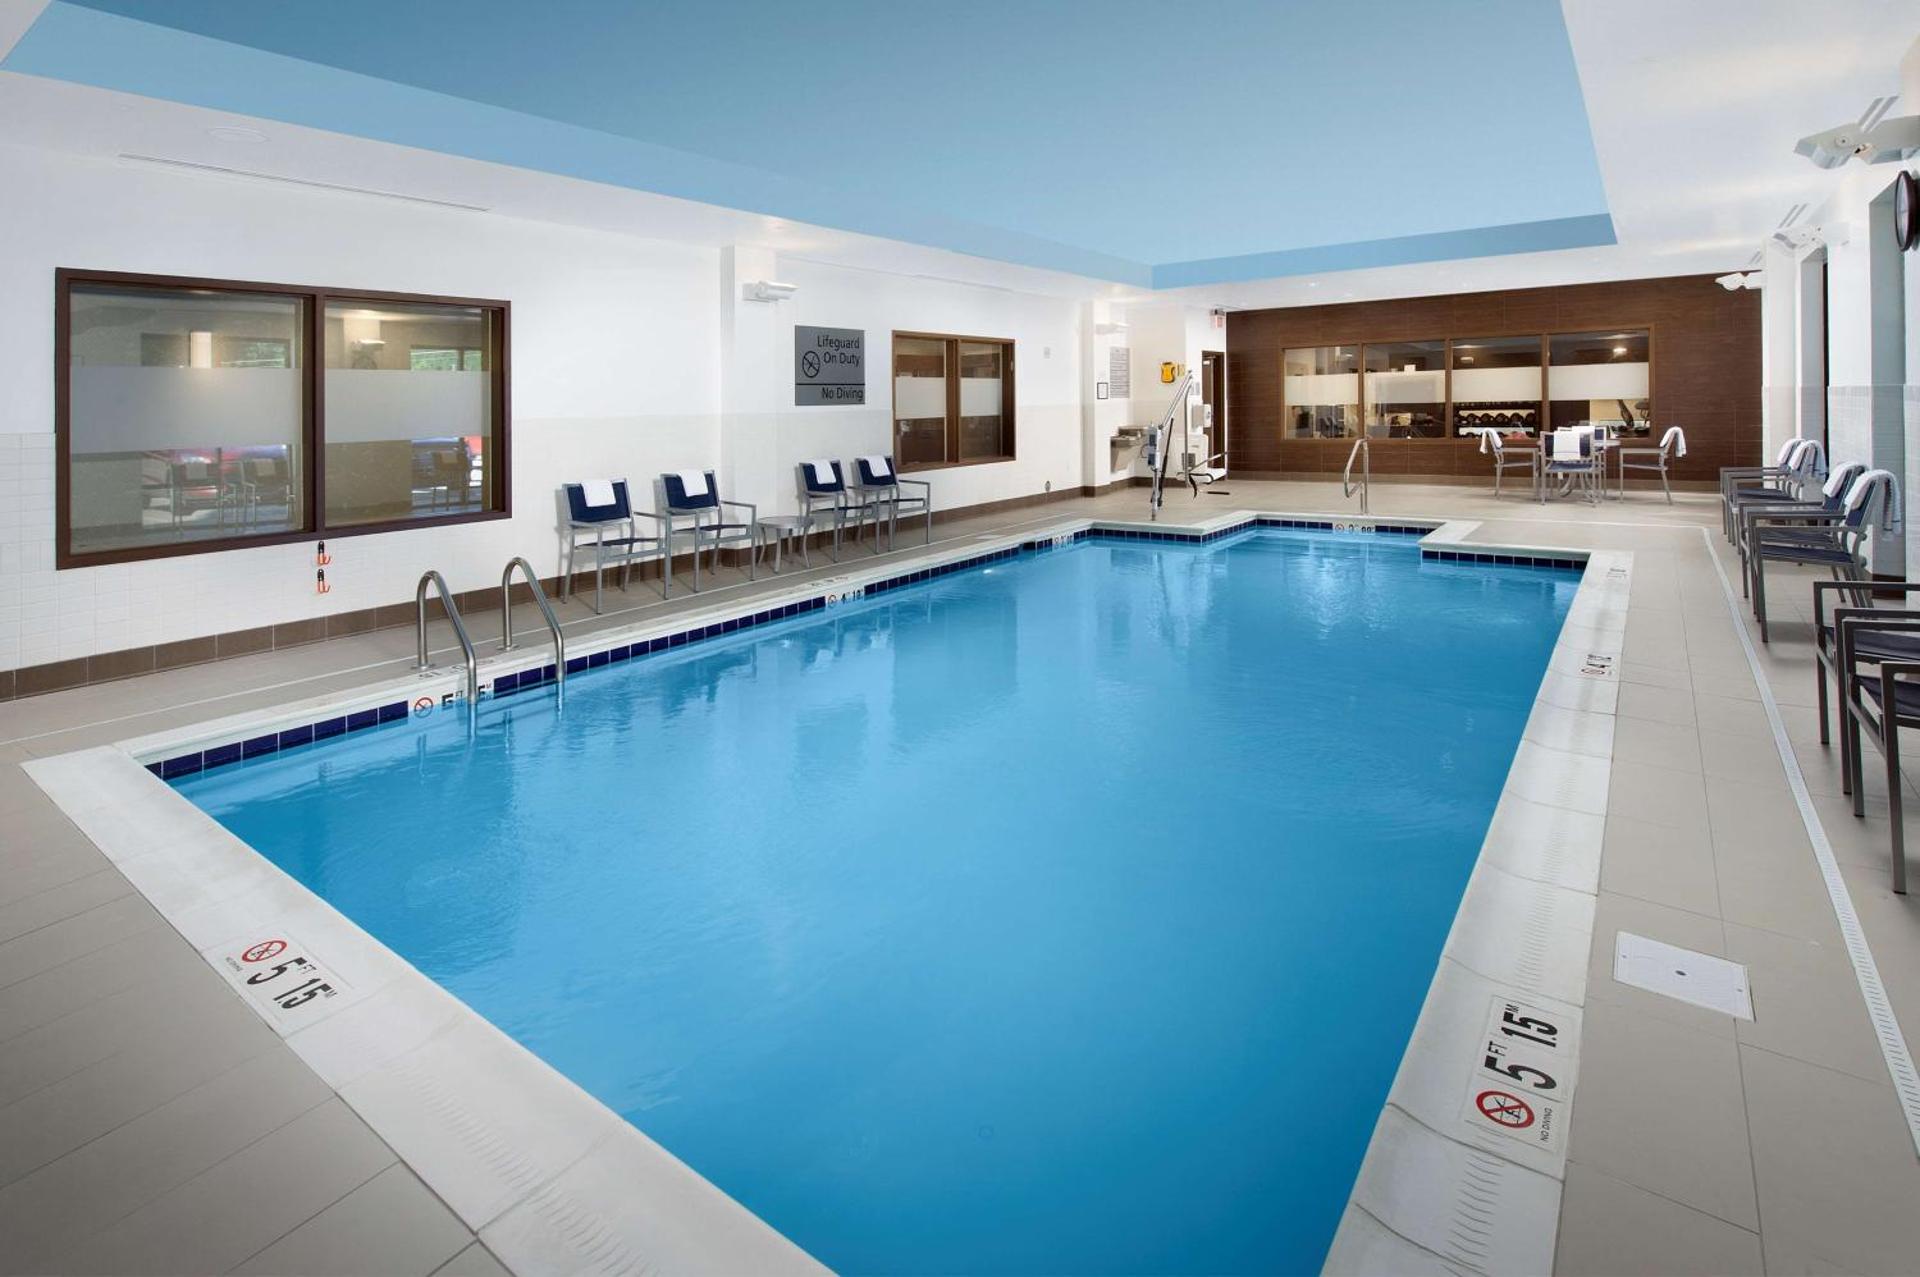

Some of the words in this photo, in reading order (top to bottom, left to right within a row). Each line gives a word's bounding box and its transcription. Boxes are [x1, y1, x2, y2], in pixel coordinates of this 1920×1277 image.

[817, 335, 859, 351] Lifeguard
[823, 351, 837, 364] On
[839, 352, 860, 367] Duty
[821, 387, 833, 400] No
[836, 387, 864, 402] Diving
[1484, 1055, 1557, 1089] 5
[1542, 1107, 1552, 1130] DIVING
[1540, 1130, 1549, 1141] NO
